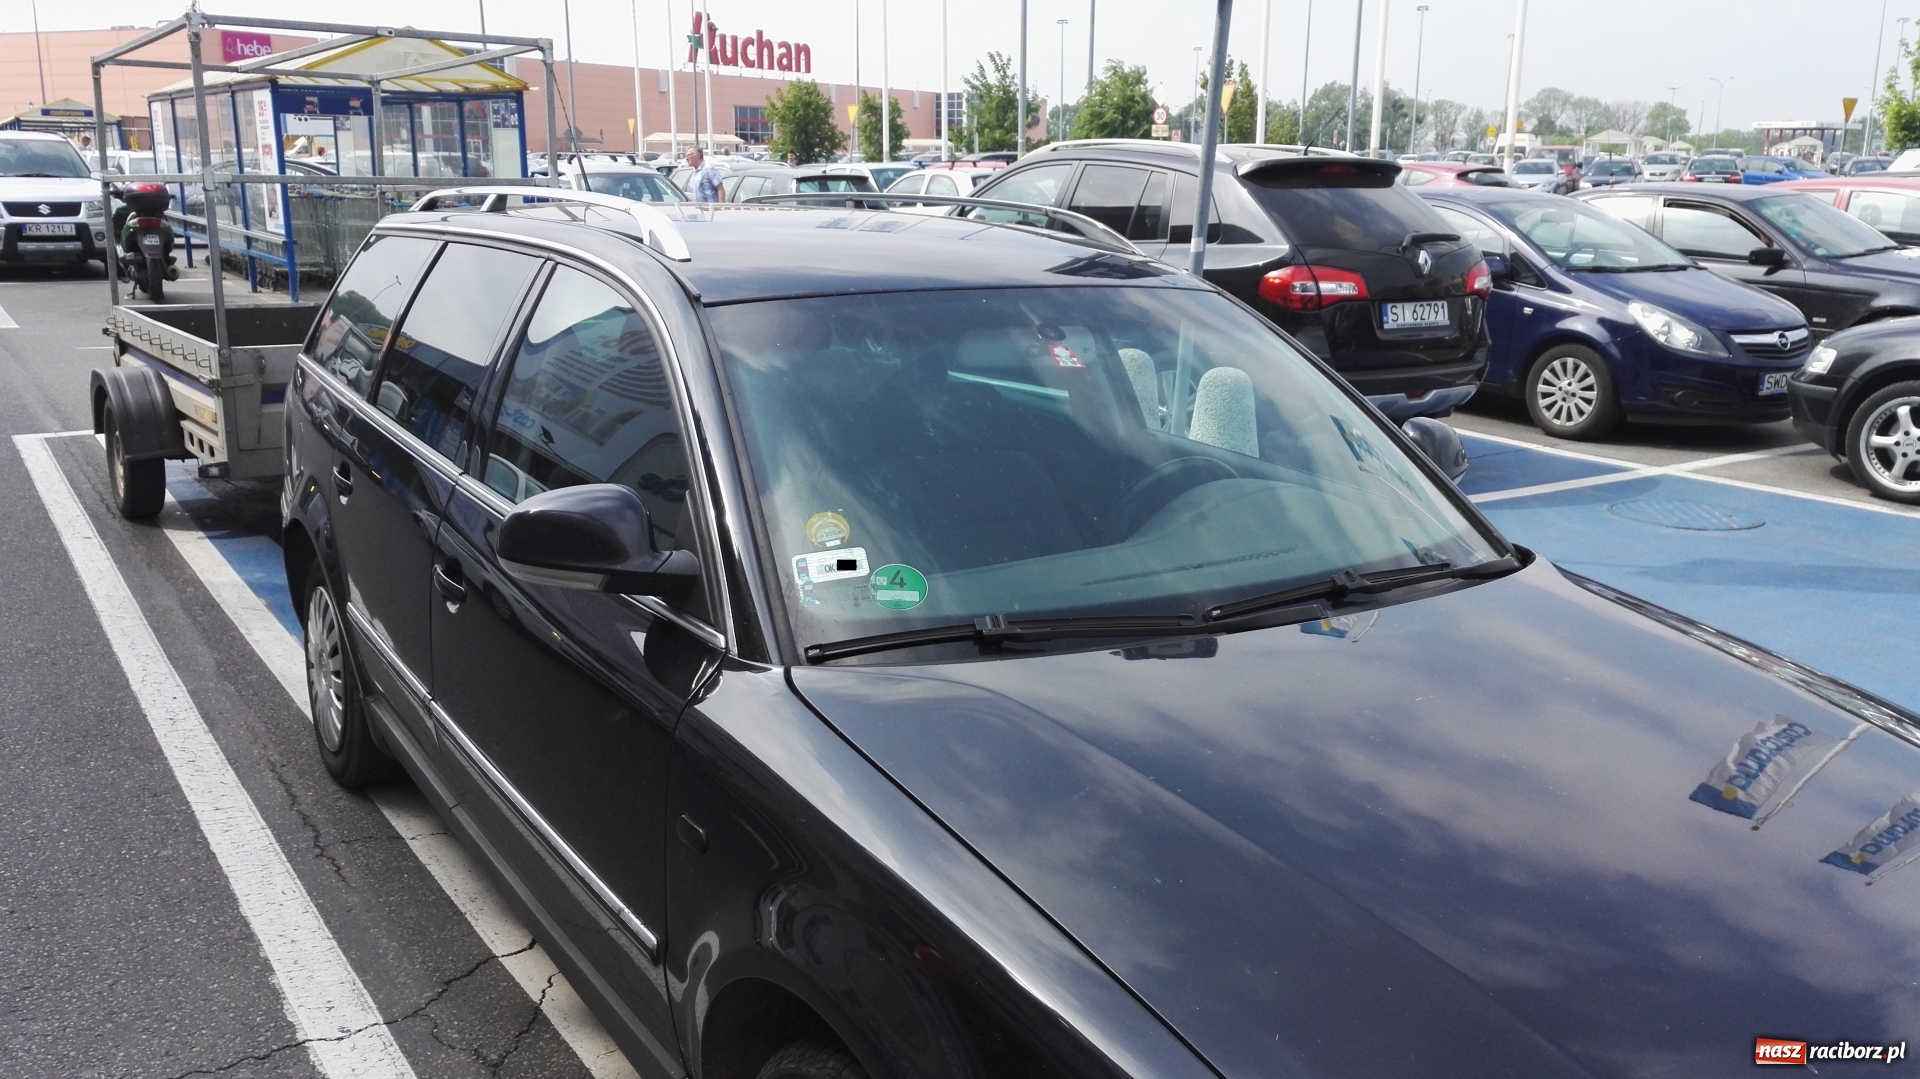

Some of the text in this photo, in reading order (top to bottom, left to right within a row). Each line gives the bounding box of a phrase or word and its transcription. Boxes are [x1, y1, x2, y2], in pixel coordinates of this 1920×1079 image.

[236, 38, 271, 56] hebe
[687, 11, 811, 73] Auchan
[1155, 111, 1165, 121] 30
[28, 224, 42, 233] KR
[1390, 302, 1446, 322] SI 62791
[1766, 374, 1788, 390] SWD
[824, 564, 836, 573] OK
[889, 569, 907, 589] 4
